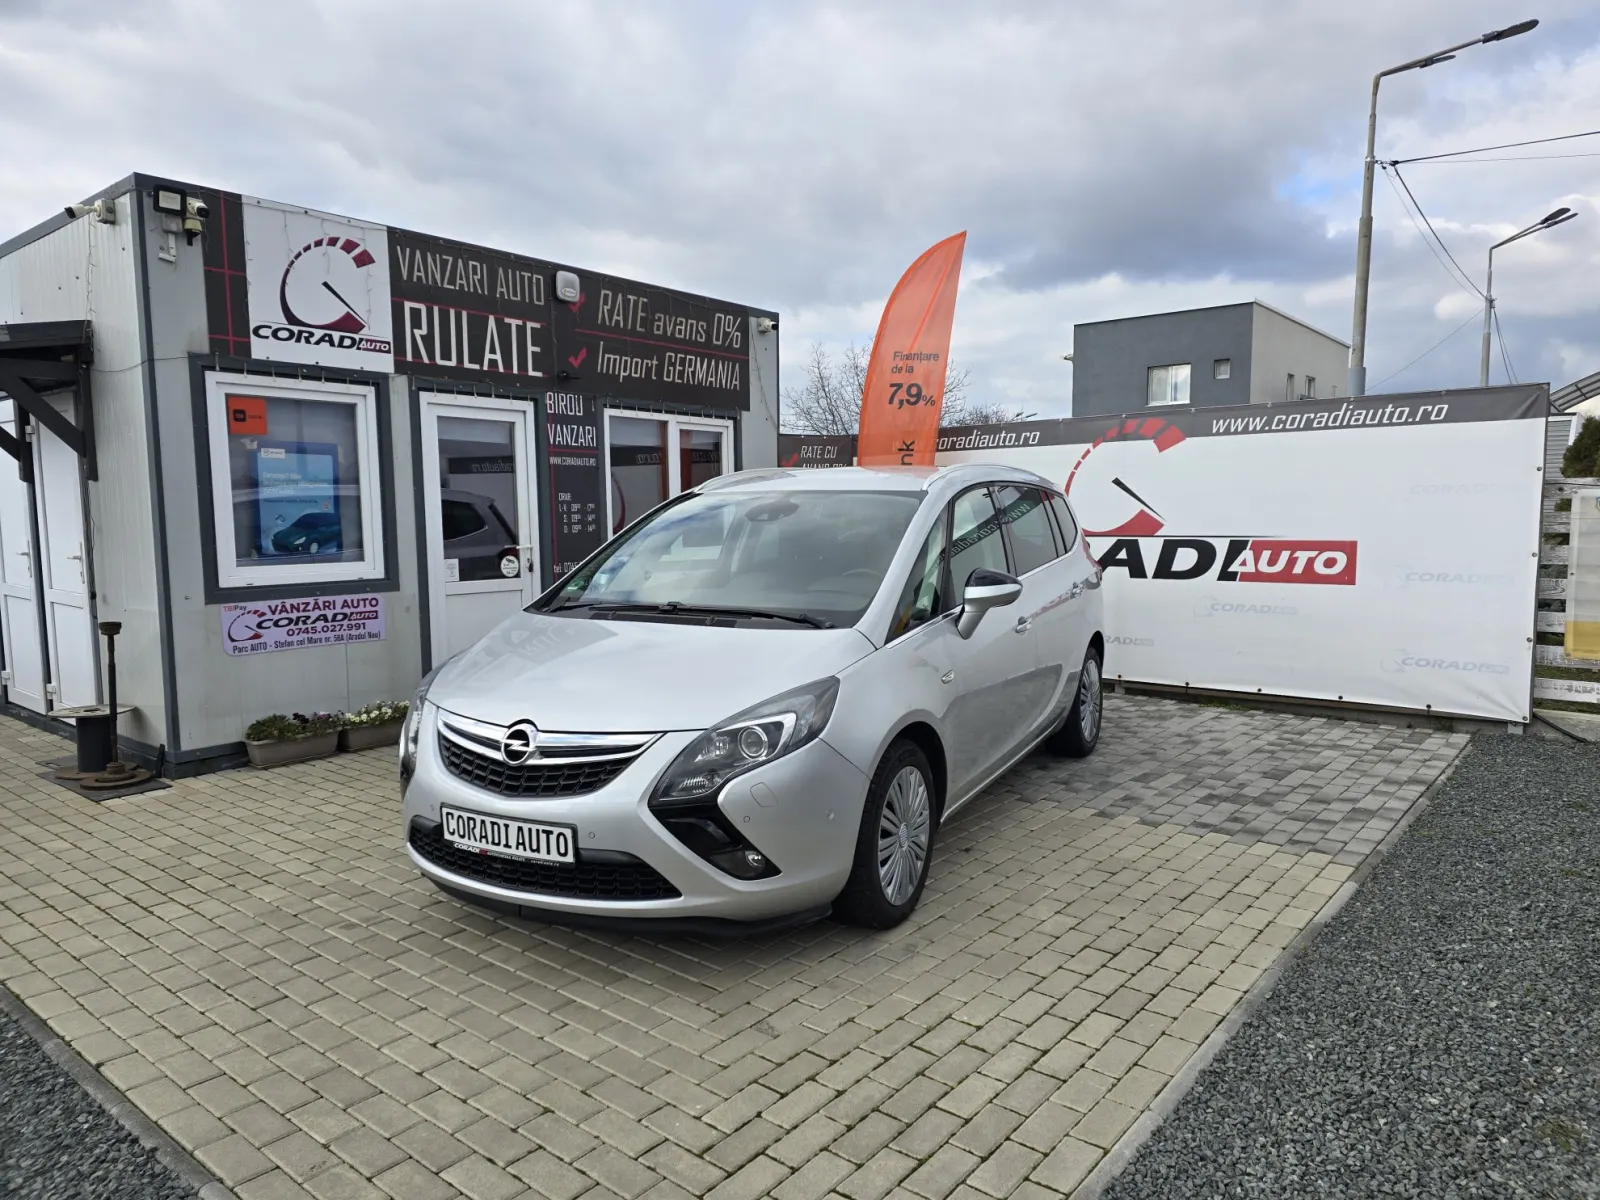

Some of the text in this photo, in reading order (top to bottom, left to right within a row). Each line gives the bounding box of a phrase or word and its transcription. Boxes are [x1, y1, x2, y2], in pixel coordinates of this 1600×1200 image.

[397, 246, 545, 305] VANZARI AUTO
[598, 289, 742, 348] RATE avans 0%
[404, 301, 543, 377] RULATE
[597, 341, 740, 390] Import GERMANIA
[891, 364, 914, 374] de la
[546, 392, 583, 416] BIROU
[888, 383, 936, 409] 7,9%
[1212, 402, 1449, 434] www.coradiauto.ro
[547, 423, 596, 447] VANZARI
[936, 430, 1040, 450] oradiauto.ro
[800, 446, 837, 459] RATE CU
[1227, 550, 1348, 574] AUTO
[267, 597, 379, 616] VÂNZĂRI AUTO
[286, 622, 366, 637] 0745.027.991
[232, 645, 249, 654] Parc
[250, 641, 268, 652] AUTO
[296, 637, 306, 646] cel
[306, 636, 323, 645] Mare
[445, 811, 569, 857] CORADI AUTO
